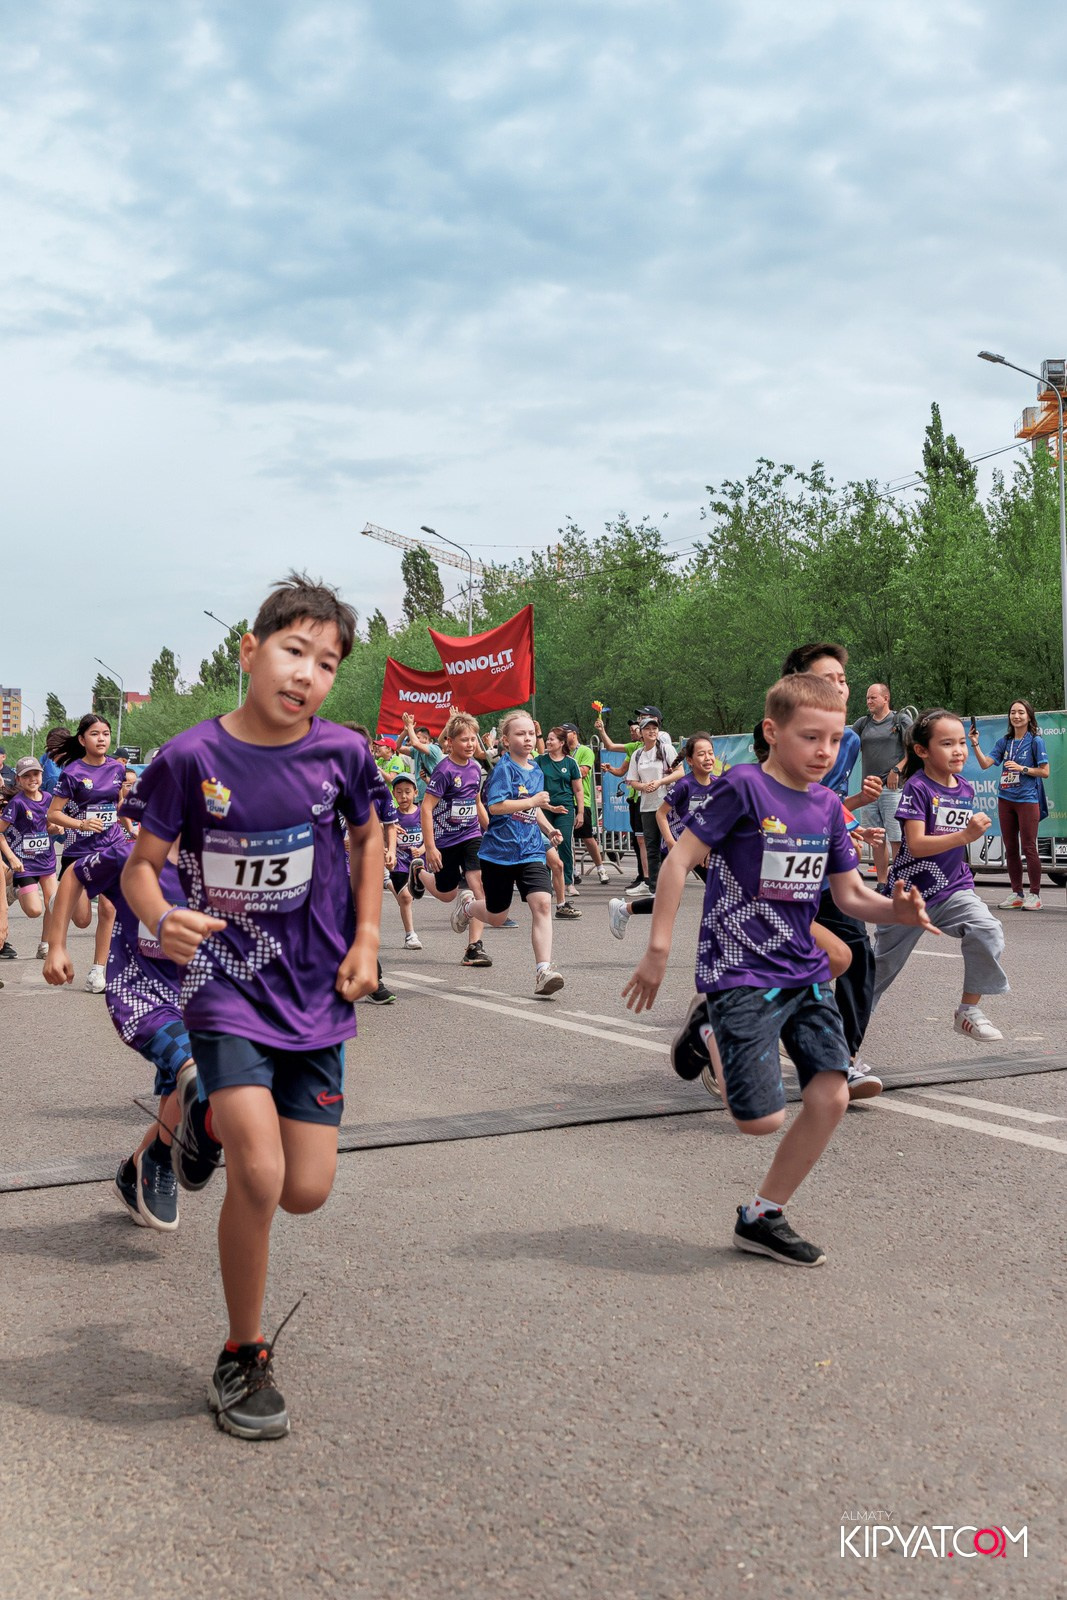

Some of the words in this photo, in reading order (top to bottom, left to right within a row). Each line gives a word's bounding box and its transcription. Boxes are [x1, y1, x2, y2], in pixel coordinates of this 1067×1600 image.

[445, 648, 513, 676] MONOLIT
[491, 661, 515, 675] GROUP
[399, 689, 452, 704] MONOLIT
[1043, 728, 1066, 736] GROUP
[28, 838, 48, 849] 004
[401, 833, 421, 844] 096
[234, 857, 290, 887] 113
[784, 855, 823, 879] 146
[208, 888, 260, 901] БАЛАЛАР
[261, 882, 309, 901] ЖАРЫСЫ
[762, 881, 805, 891] БАЛАЛАР
[792, 891, 808, 900] 600
[244, 902, 268, 912] 600
